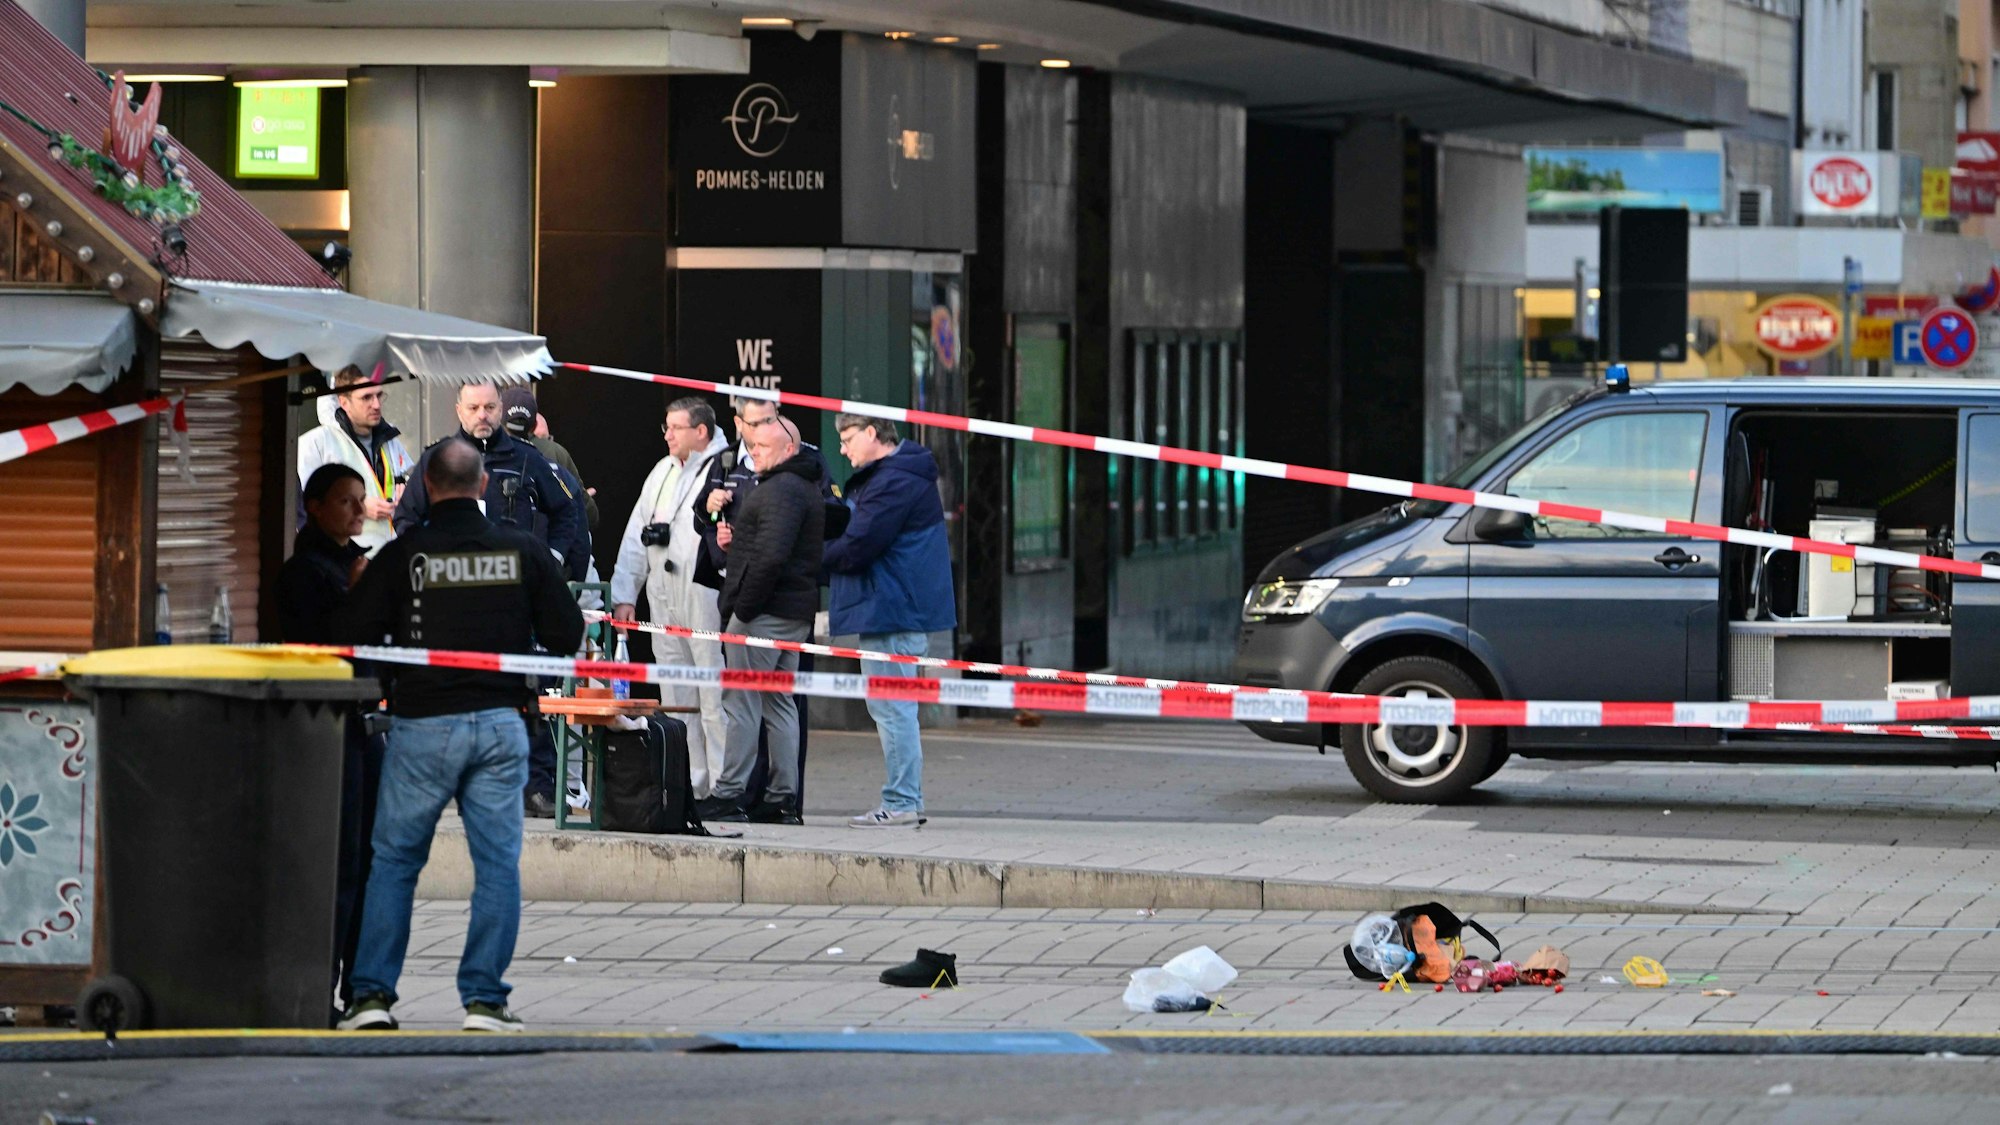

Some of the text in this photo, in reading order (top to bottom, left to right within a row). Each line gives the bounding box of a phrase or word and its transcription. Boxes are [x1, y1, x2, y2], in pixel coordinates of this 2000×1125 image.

[736, 338, 773, 371] WE
[1902, 325, 1921, 360] P
[429, 555, 517, 583] POLIZEI
